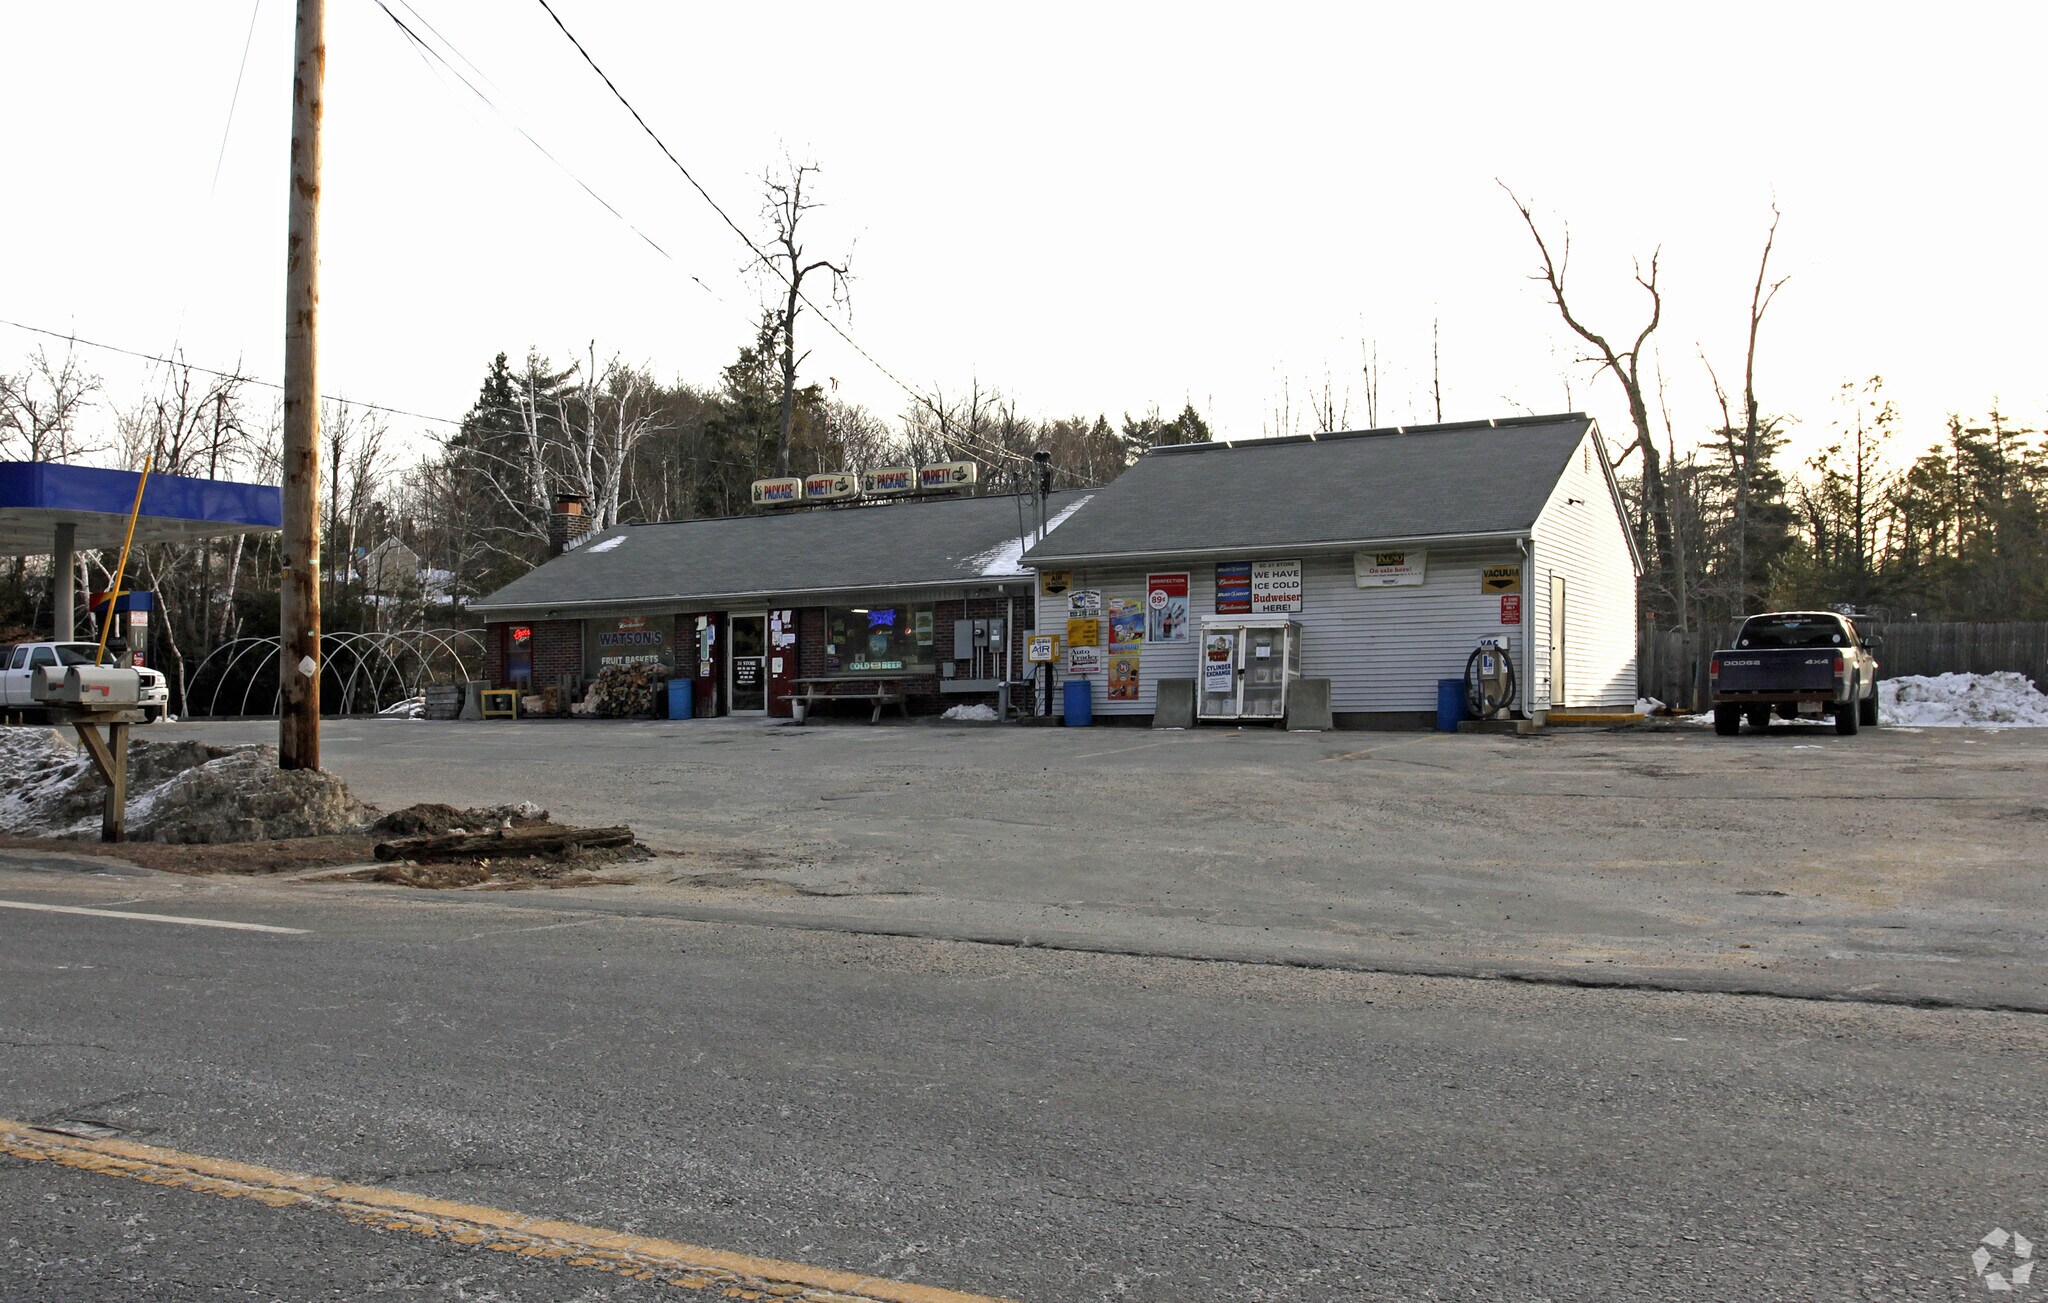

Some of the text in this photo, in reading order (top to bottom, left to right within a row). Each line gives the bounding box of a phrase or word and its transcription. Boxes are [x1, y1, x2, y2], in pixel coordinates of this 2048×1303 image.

[877, 472, 909, 489] PACKAGE
[922, 468, 951, 484] VARIETY
[764, 483, 794, 499] PACKAGE
[806, 479, 833, 495] VARIETY
[1254, 570, 1300, 579] WE HAVE
[1483, 569, 1519, 578] VACUUM
[1272, 581, 1300, 589] COLD
[1253, 593, 1303, 603] Budweiser
[1262, 604, 1291, 612] HERE!
[600, 632, 661, 645] WATSON'S
[1032, 645, 1050, 653] AIR
[625, 655, 658, 664] BASKETS
[849, 662, 869, 670] COLD
[882, 661, 902, 669] BEER
[1207, 664, 1231, 672] CYLINDER
